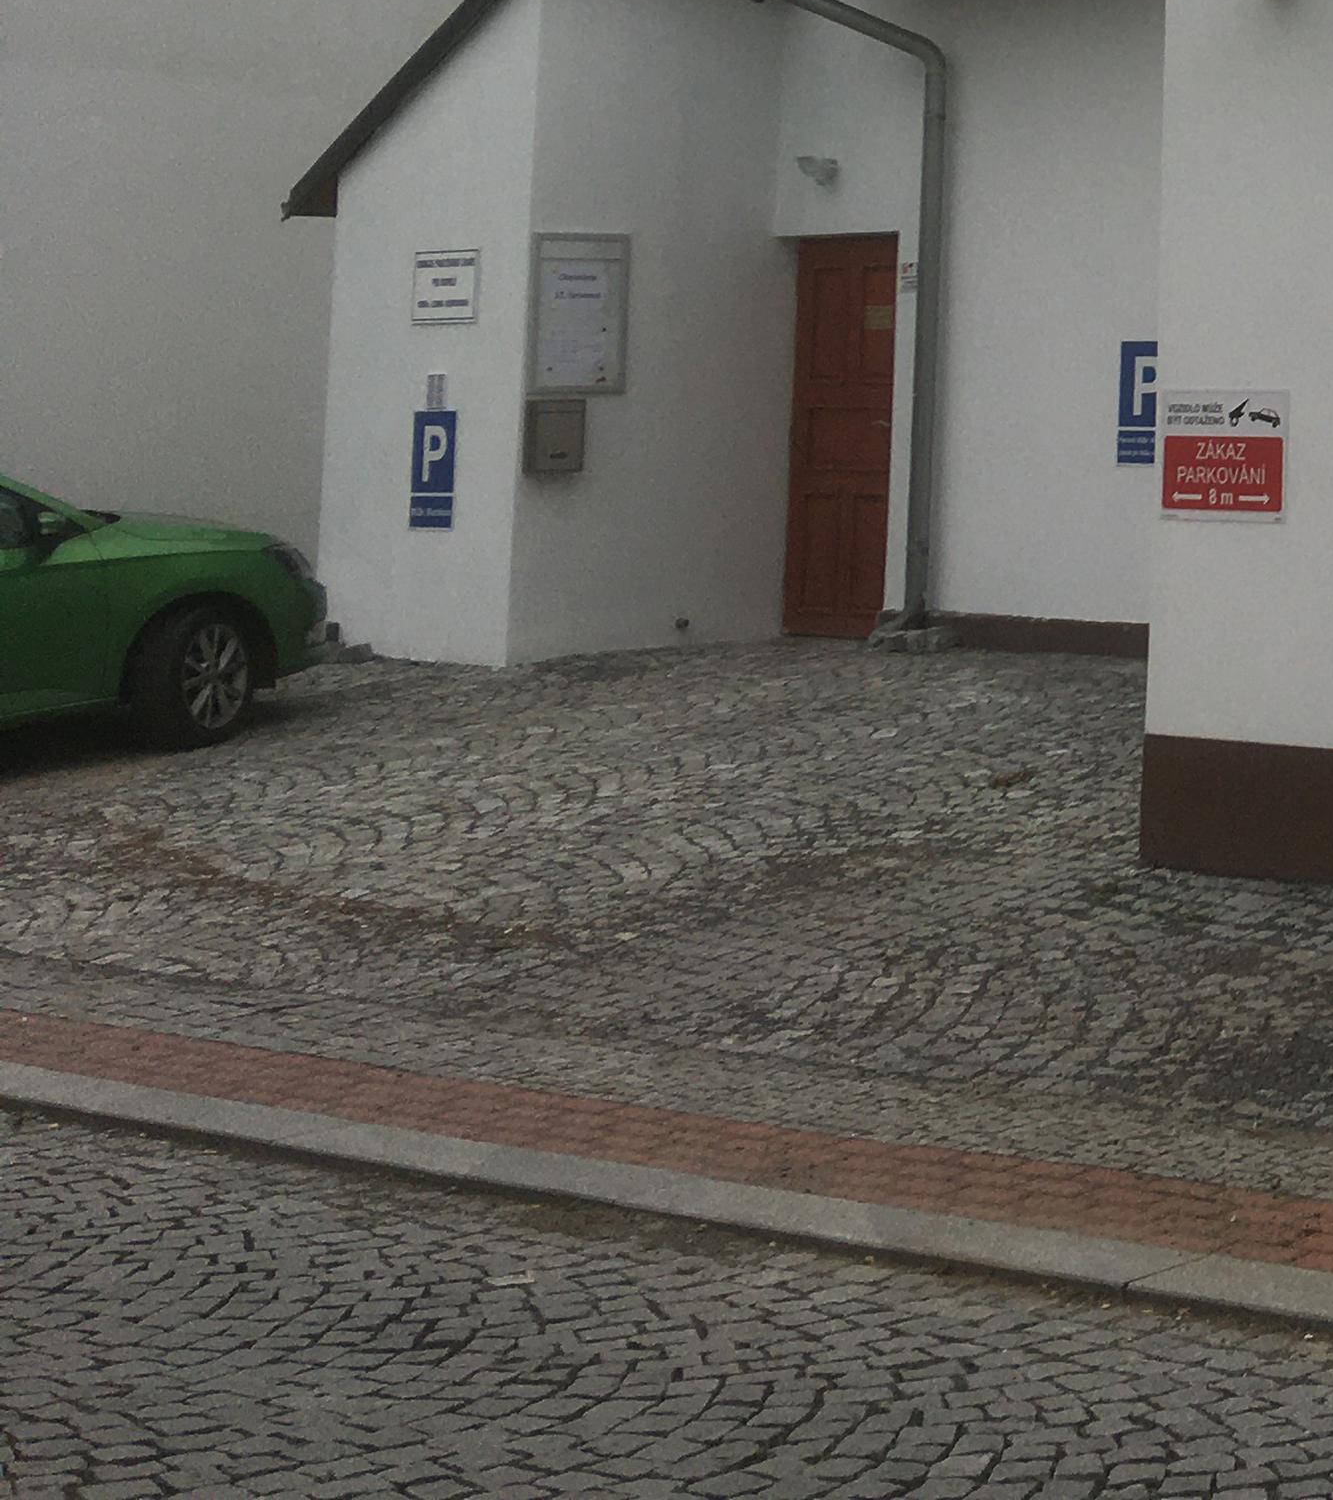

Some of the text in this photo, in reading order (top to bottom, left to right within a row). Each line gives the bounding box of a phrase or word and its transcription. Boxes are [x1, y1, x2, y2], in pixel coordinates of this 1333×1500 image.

[1132, 356, 1158, 416] P
[420, 425, 448, 482] P
[1196, 440, 1246, 461] ZÁKAZ
[1177, 464, 1266, 485] PARKOVÁNÍ
[1208, 488, 1234, 505] 8 m
